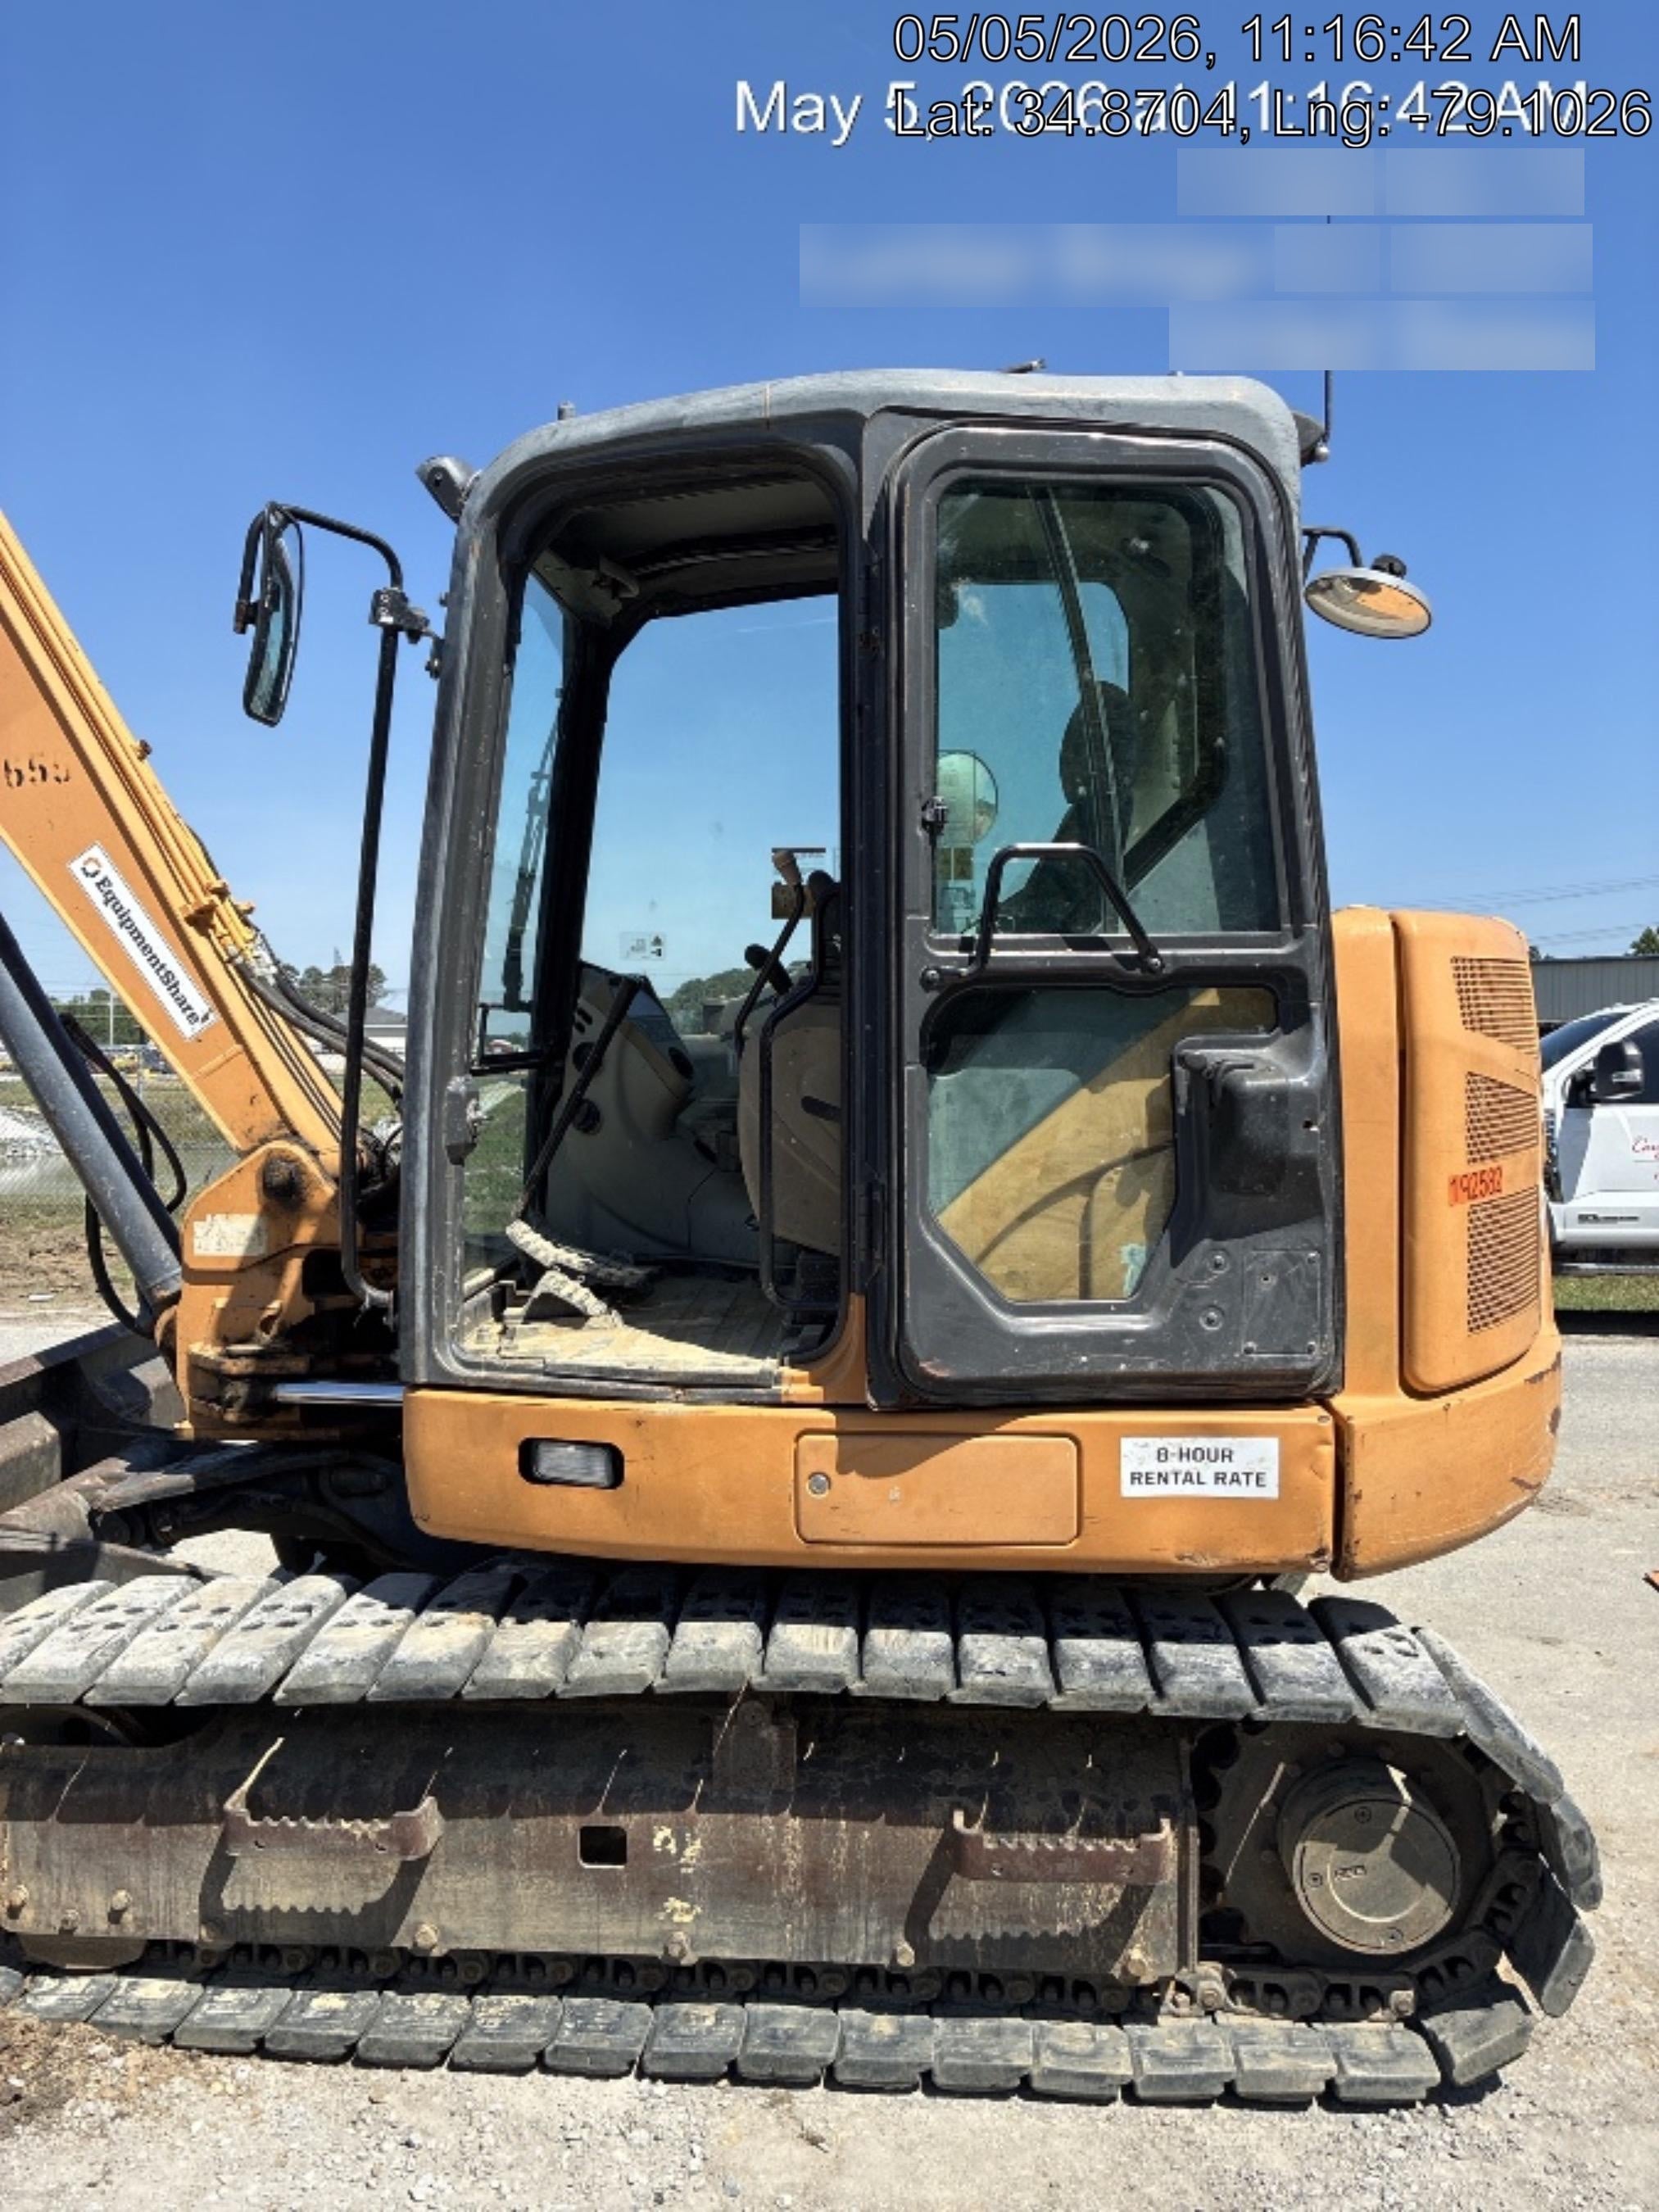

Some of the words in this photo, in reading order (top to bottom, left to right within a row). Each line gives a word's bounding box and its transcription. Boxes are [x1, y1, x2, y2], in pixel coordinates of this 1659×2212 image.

[95, 875, 200, 1026] EquipmentShare
[1156, 1447, 1235, 1464] 8-HOUR
[1130, 1471, 1206, 1486] RENTAL
[1213, 1471, 1267, 1488] RATE
